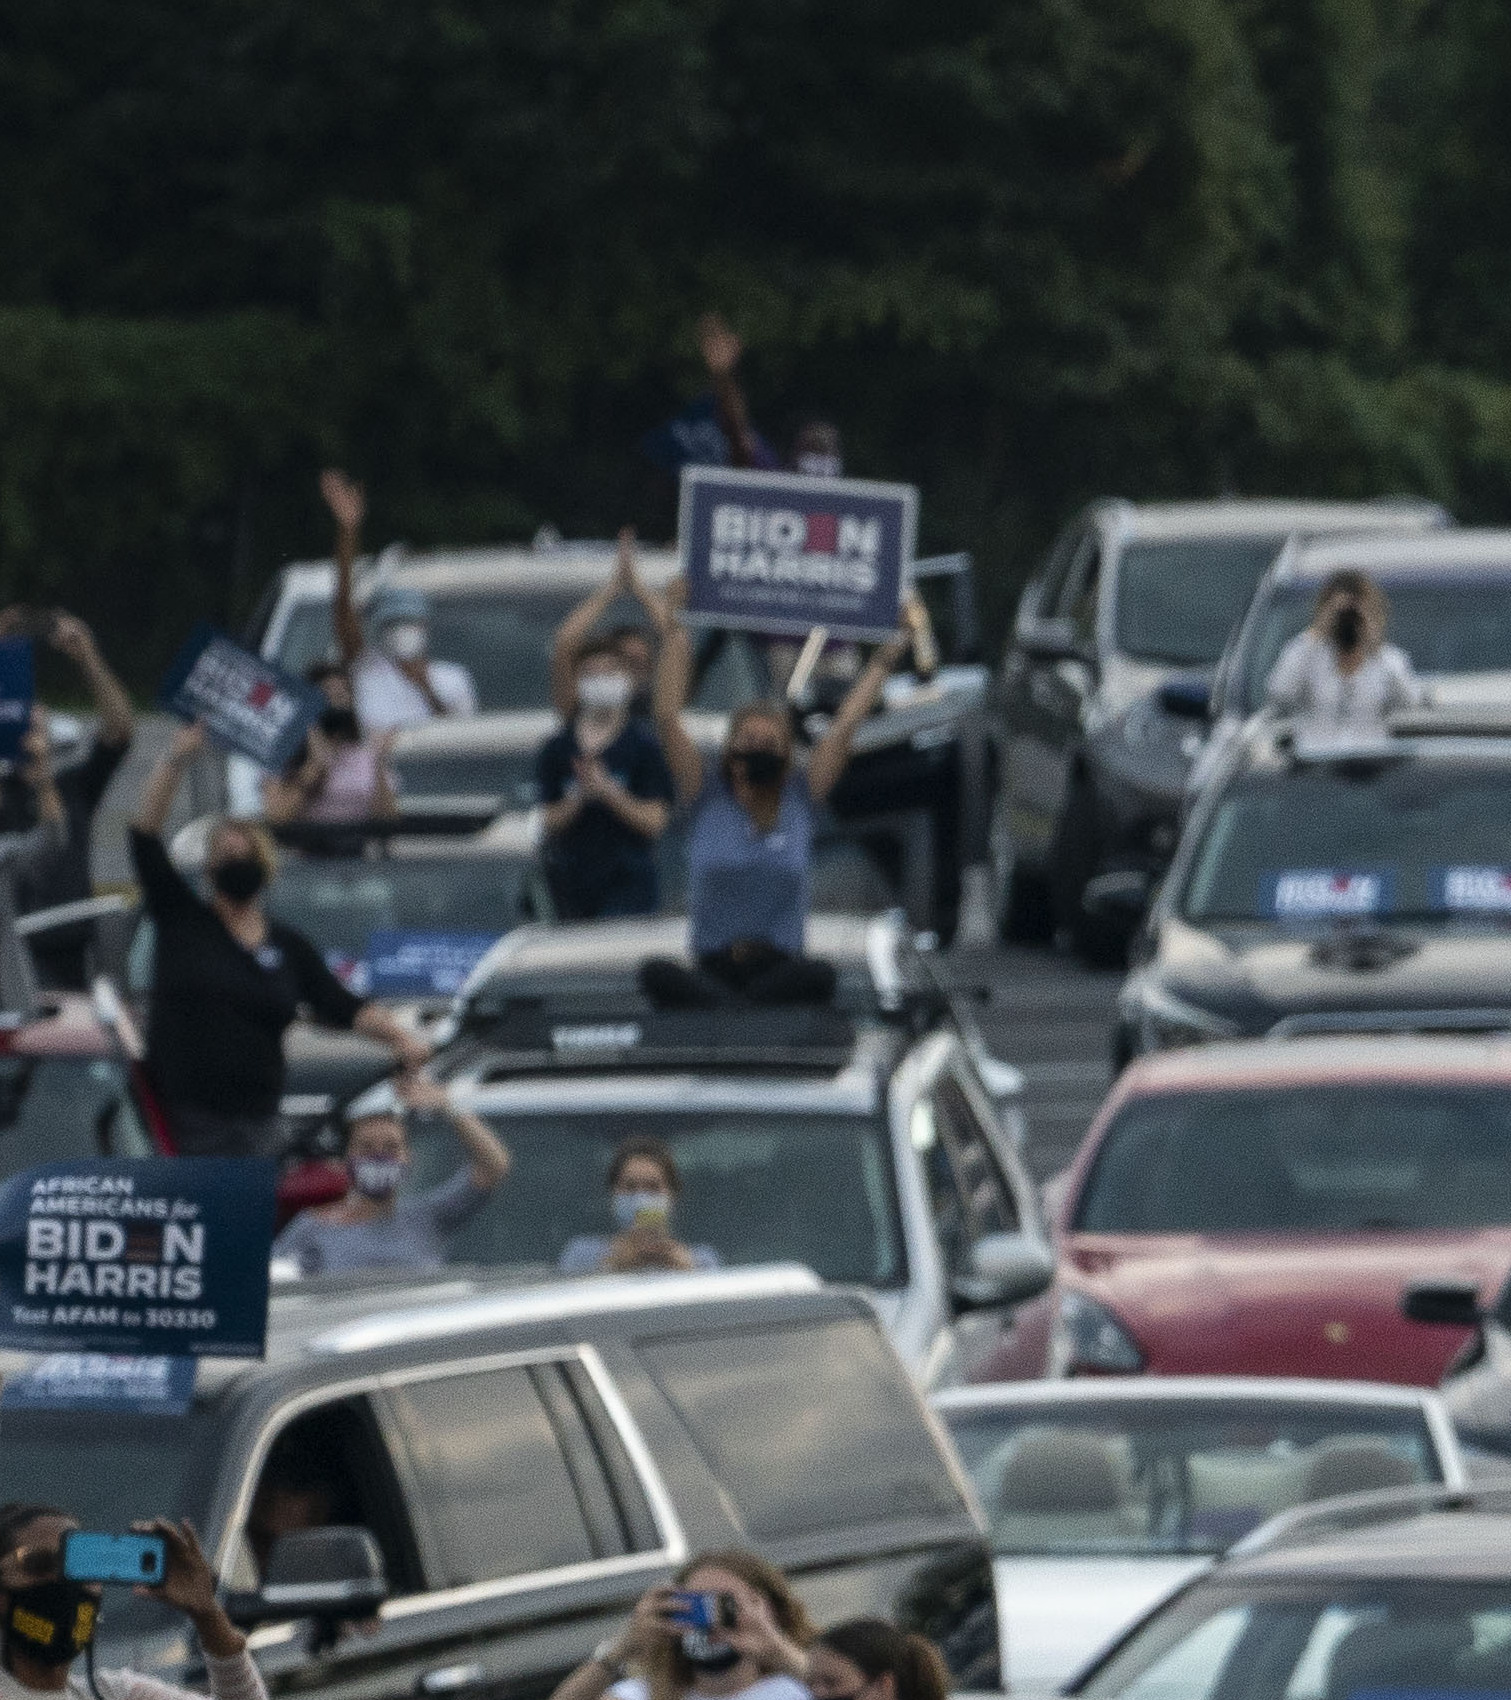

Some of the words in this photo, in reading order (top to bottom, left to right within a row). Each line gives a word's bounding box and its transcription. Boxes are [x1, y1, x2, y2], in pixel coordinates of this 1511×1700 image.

[31, 1175, 135, 1196] AFRICAN
[30, 1196, 169, 1219] AMERICANS
[26, 1218, 205, 1264] BIDEN
[24, 1262, 202, 1300] HARRIS
